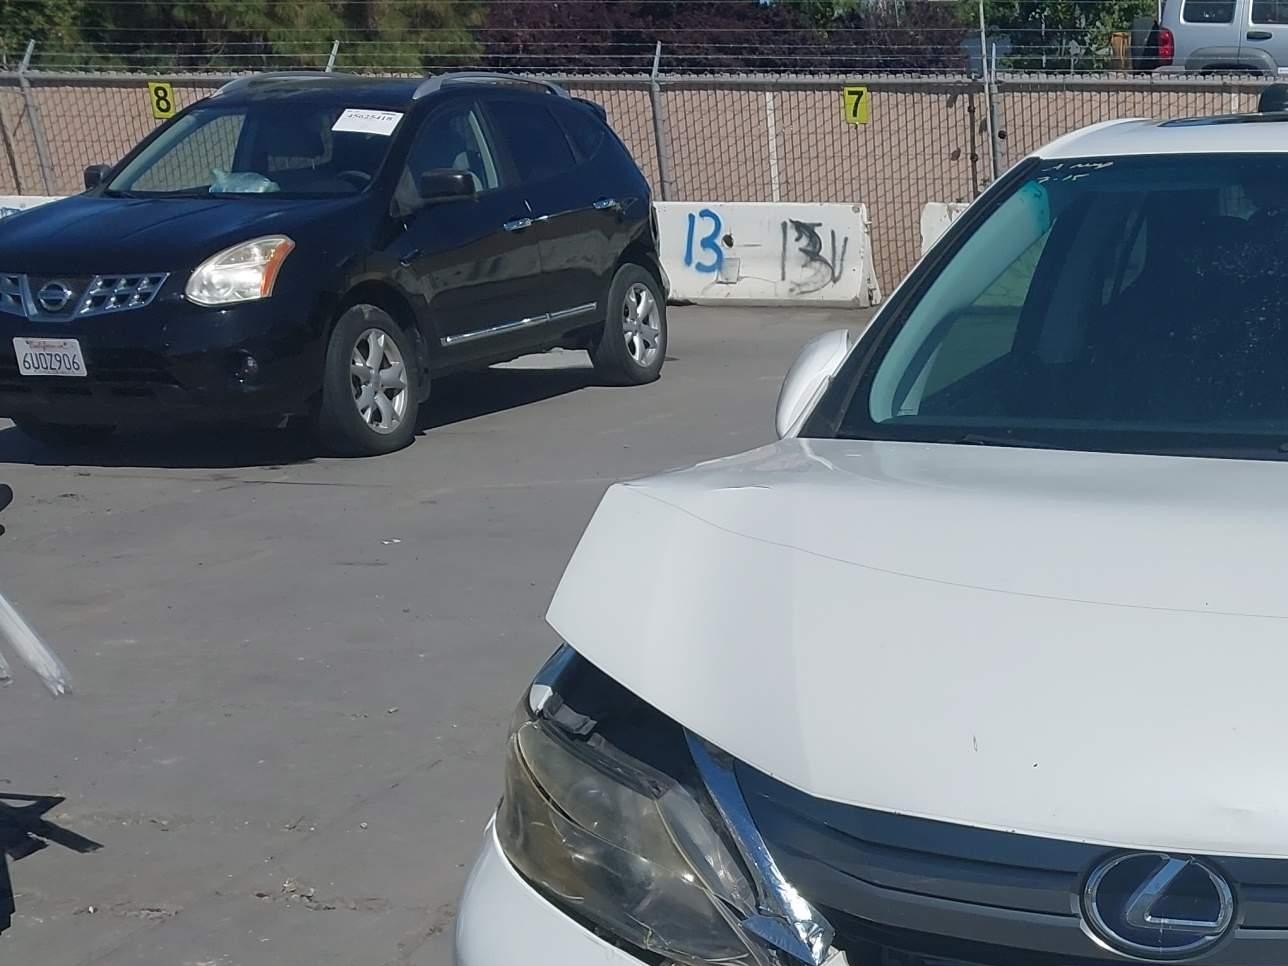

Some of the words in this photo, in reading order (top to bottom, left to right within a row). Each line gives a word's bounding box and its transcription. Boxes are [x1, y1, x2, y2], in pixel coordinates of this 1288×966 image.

[153, 85, 172, 113] 8
[847, 90, 864, 118] 7
[684, 208, 724, 274] 13
